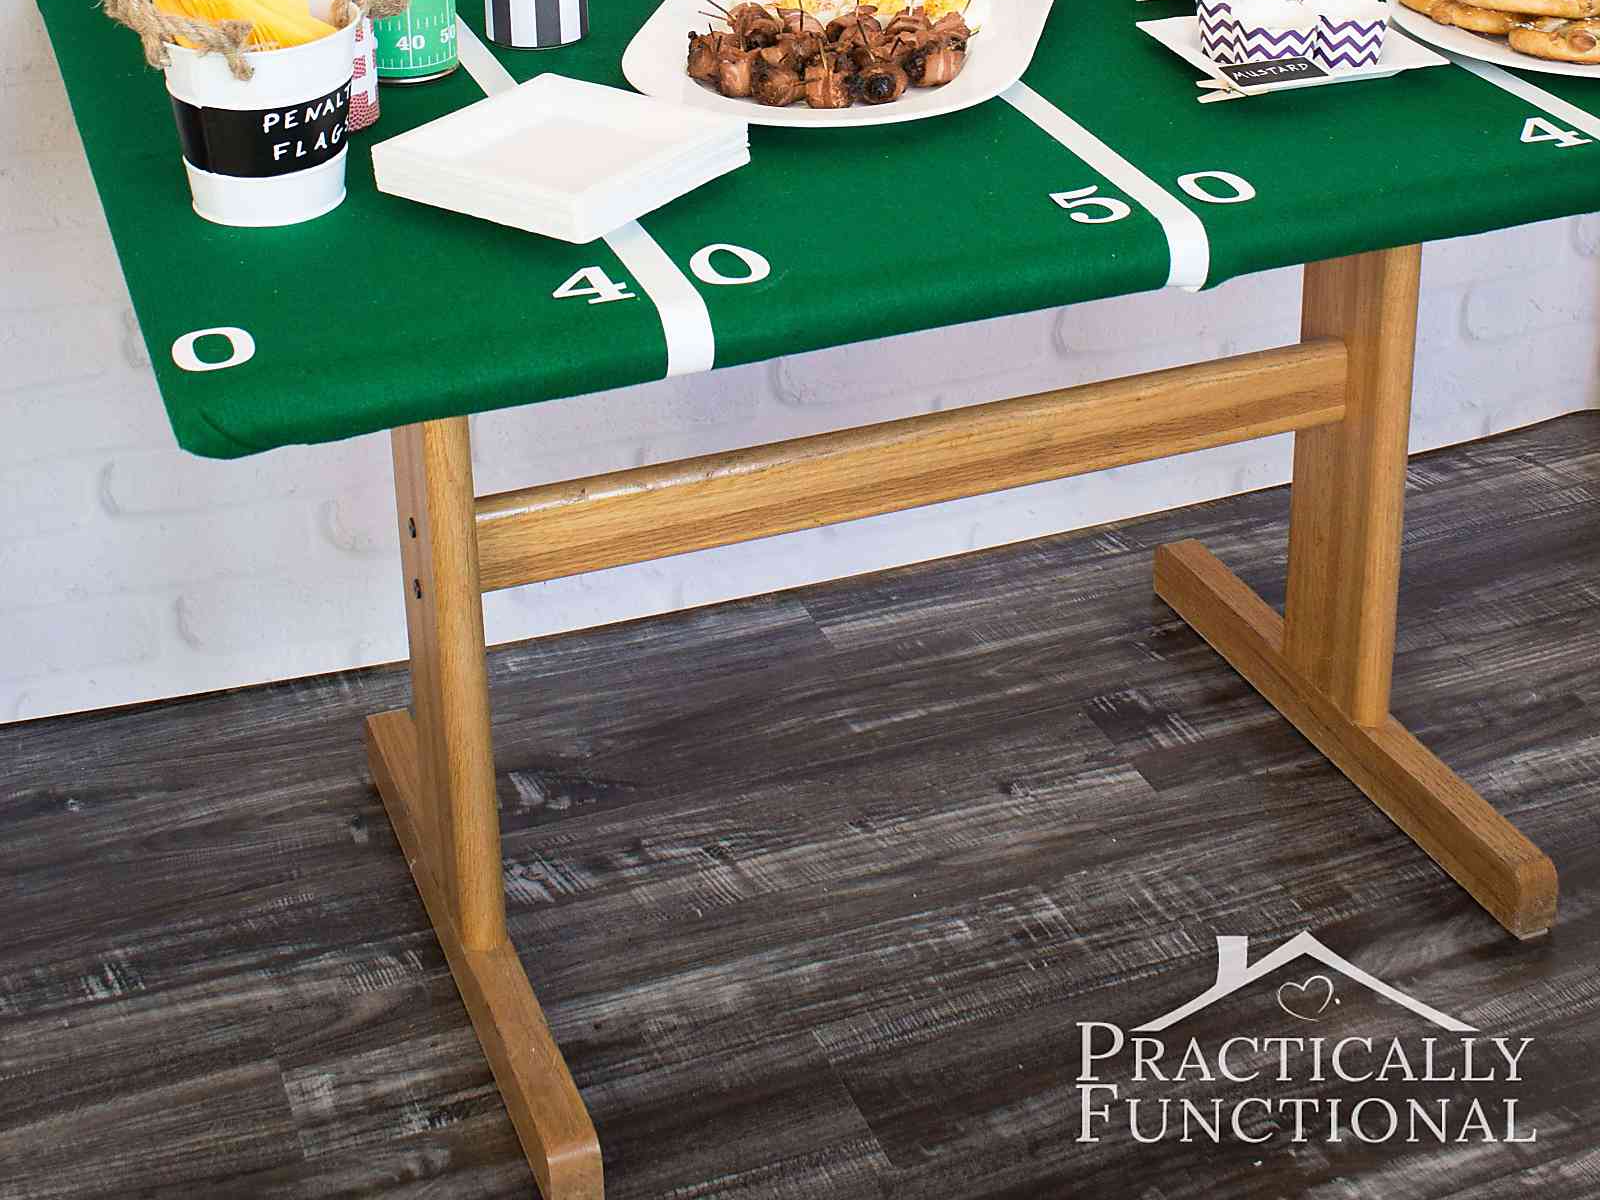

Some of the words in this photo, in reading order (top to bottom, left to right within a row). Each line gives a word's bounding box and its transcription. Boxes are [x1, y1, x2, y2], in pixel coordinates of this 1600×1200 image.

[396, 34, 426, 51] 40
[440, 23, 456, 44] 50
[1232, 63, 1309, 81] MUSTARD
[263, 83, 351, 133] PENALT
[1520, 117, 1592, 148] 4
